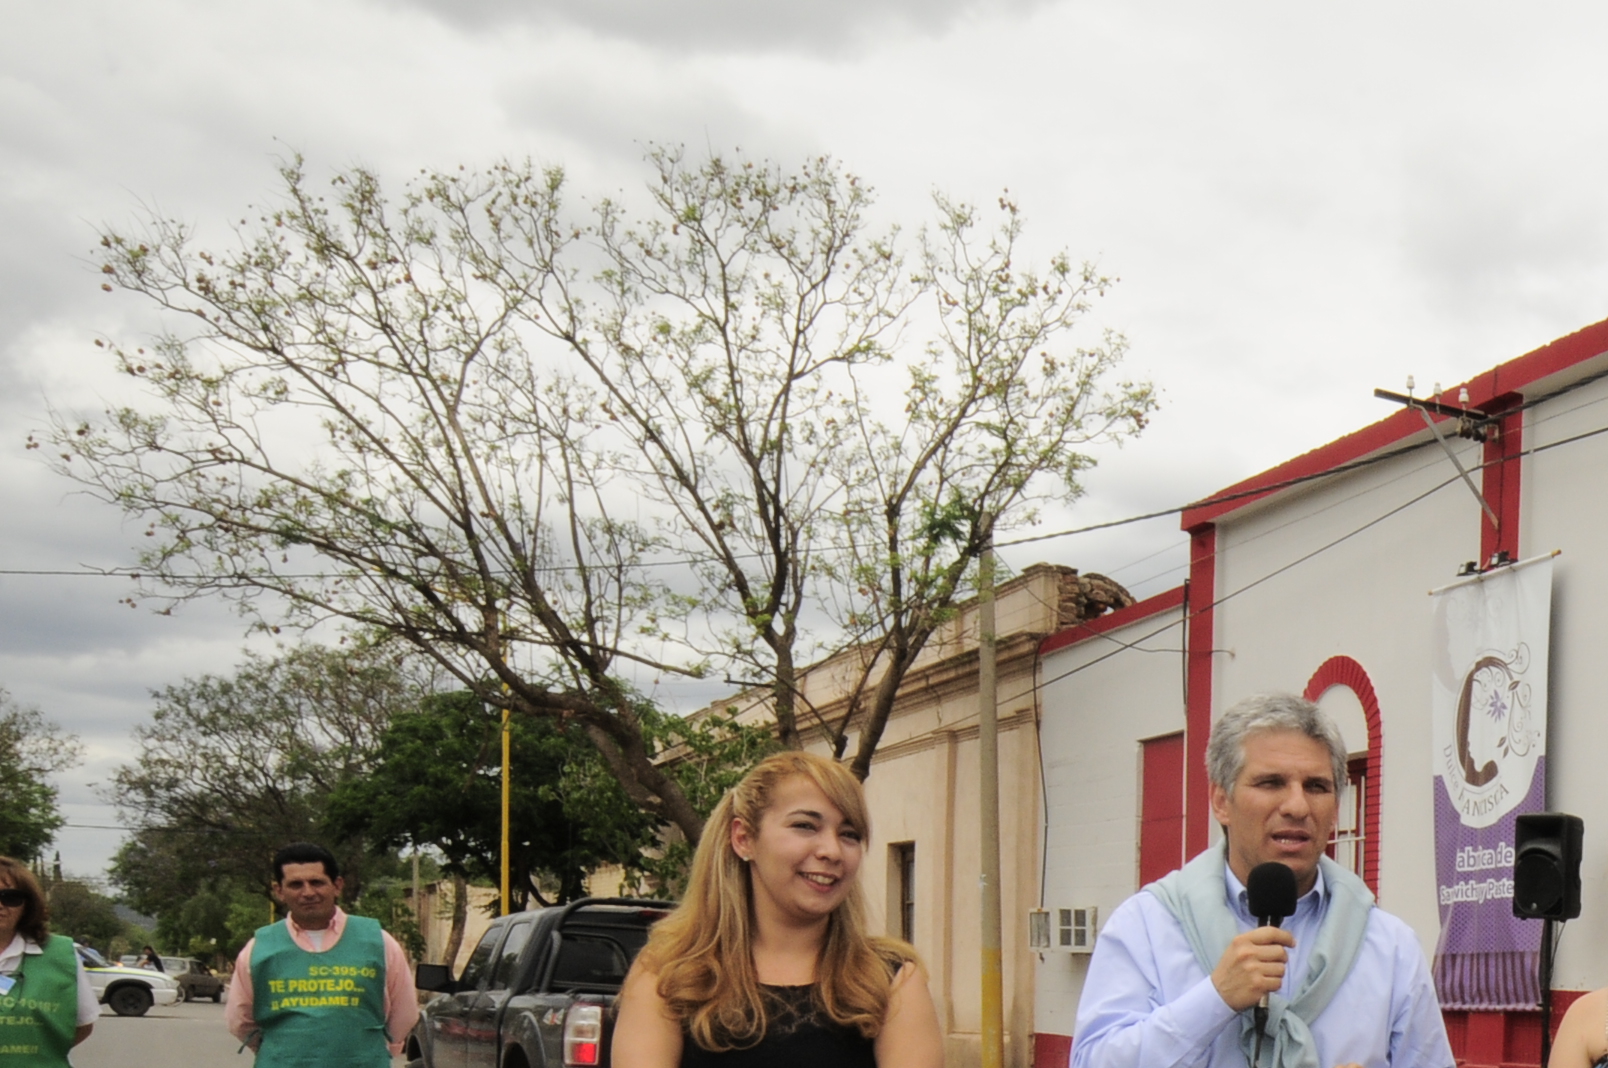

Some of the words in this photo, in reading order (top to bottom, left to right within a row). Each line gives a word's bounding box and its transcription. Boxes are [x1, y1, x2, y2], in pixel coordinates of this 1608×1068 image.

[1487, 878, 1515, 899] Paste
[269, 980, 285, 993] TE
[288, 979, 365, 992] PROTEJO...
[281, 996, 349, 1008] AYUDAME
